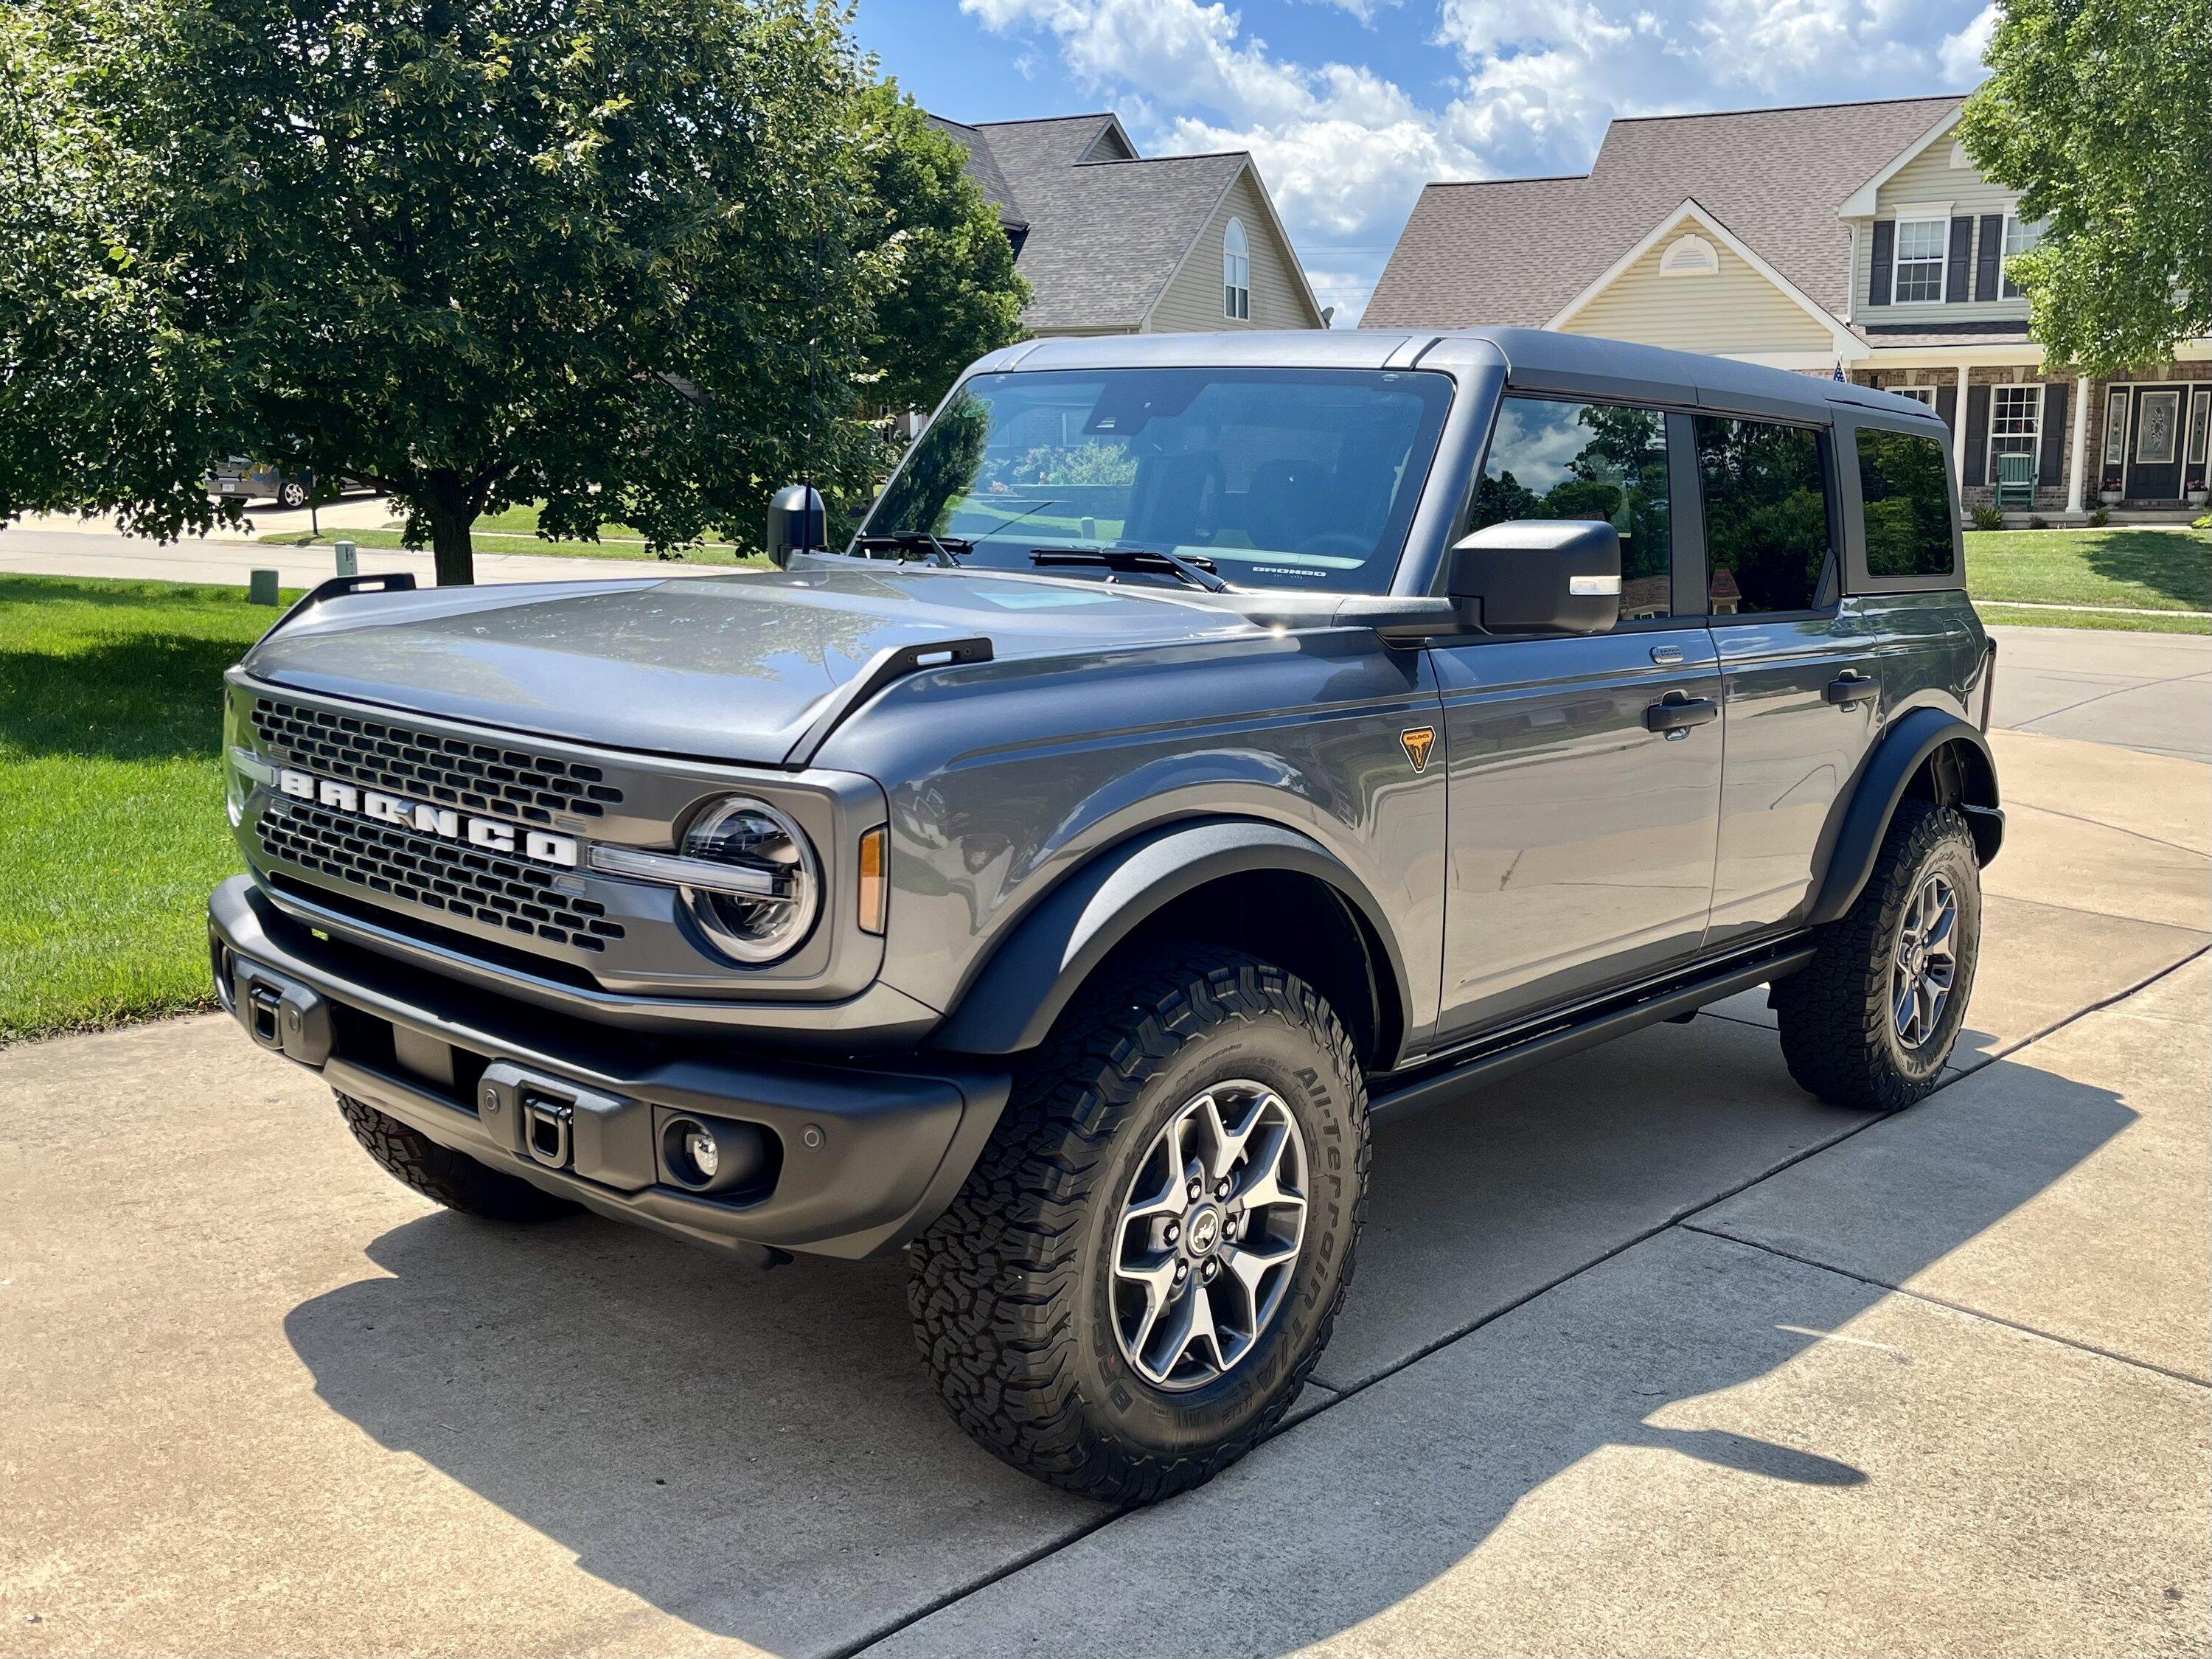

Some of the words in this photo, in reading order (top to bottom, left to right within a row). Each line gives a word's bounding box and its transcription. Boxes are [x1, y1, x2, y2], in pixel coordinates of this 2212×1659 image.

[1253, 566, 1326, 577] BRONCO
[280, 768, 577, 866] BRONCO
[1293, 1066, 1342, 1310] All-Terrain
[1256, 1317, 1309, 1393] T/A
